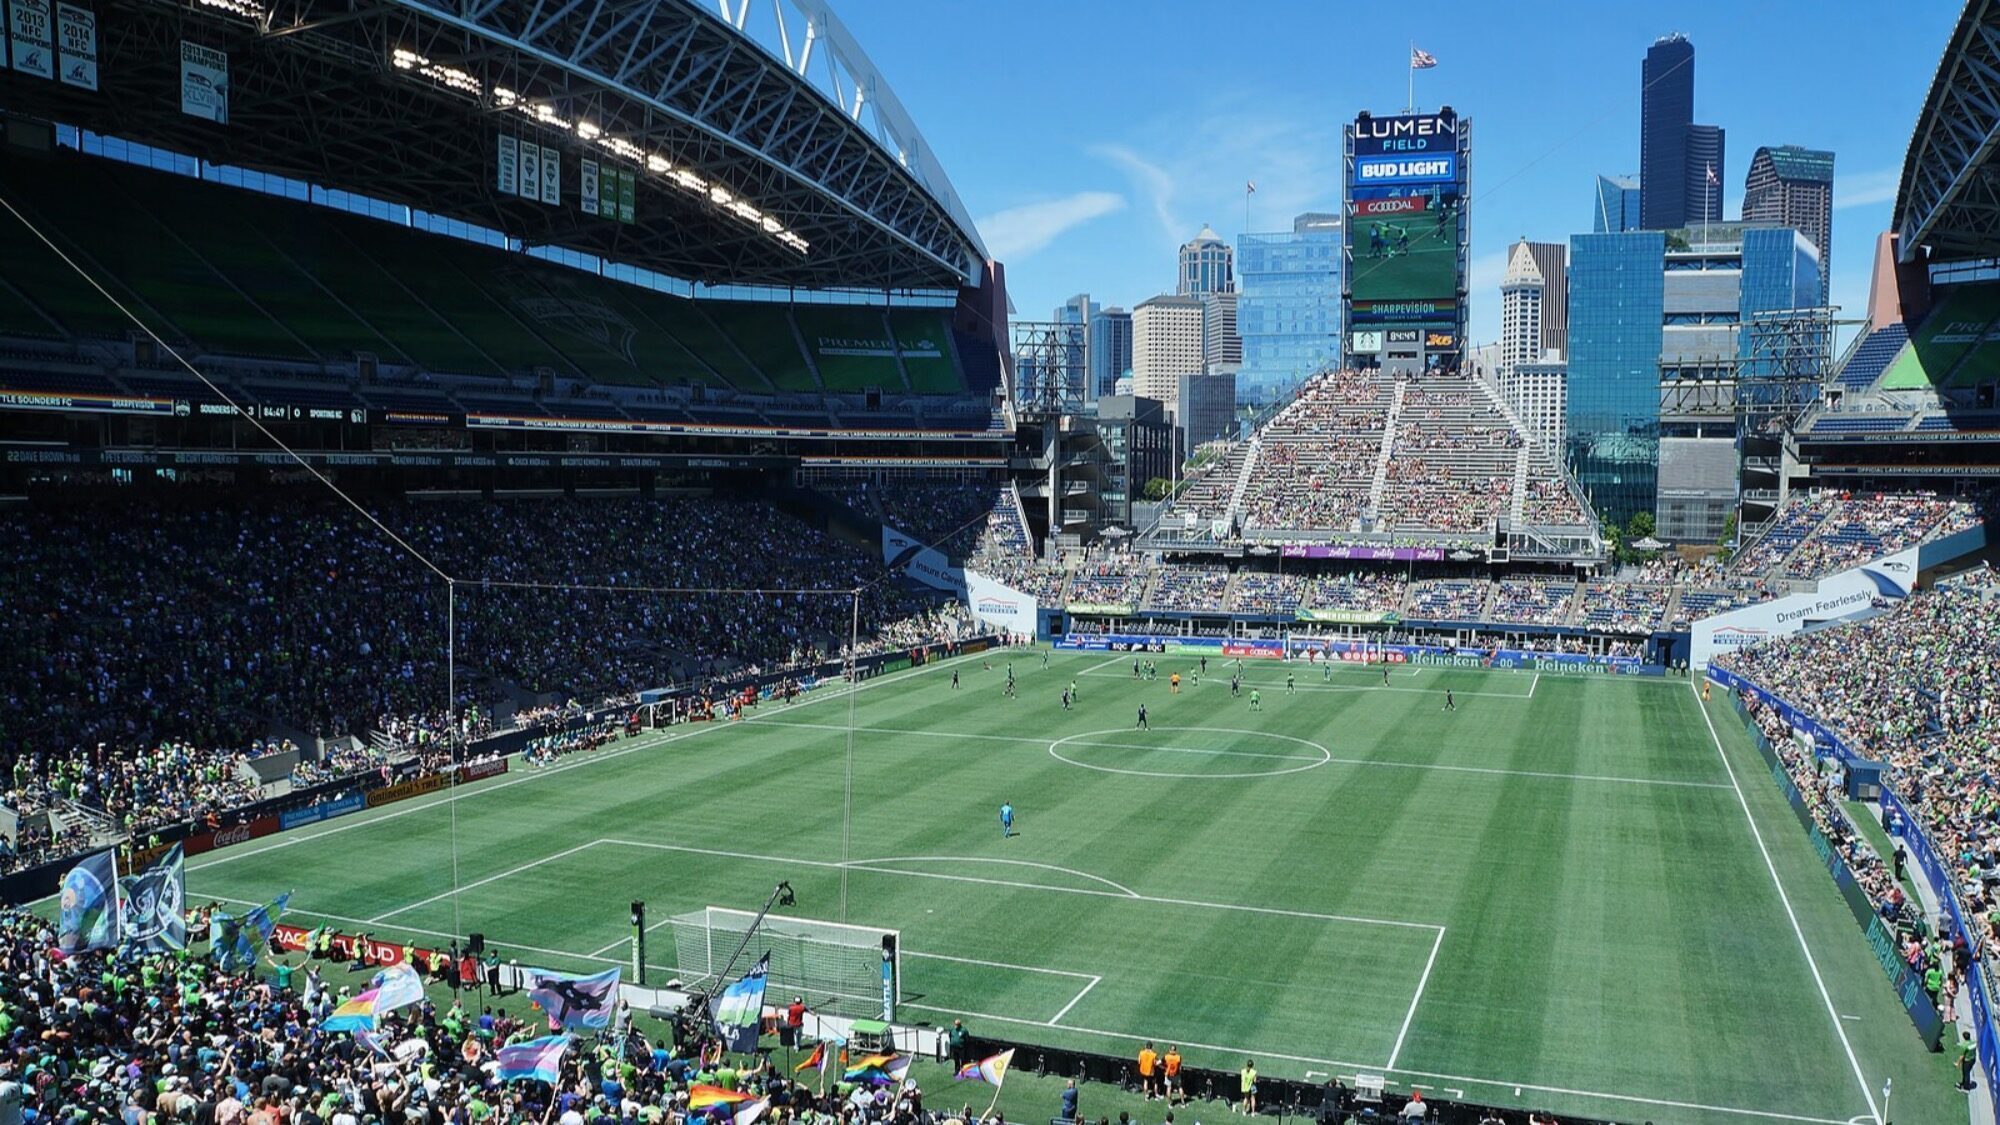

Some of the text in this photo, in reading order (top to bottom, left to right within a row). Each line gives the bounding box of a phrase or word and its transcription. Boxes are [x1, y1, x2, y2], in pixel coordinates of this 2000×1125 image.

[16, 8, 45, 28] 2013
[21, 23, 42, 38] NFC
[63, 22, 90, 42] 2014
[12, 32, 52, 50] CHAMPIONS
[68, 38, 88, 51] NFC
[60, 45, 97, 63] CHAMPIONS
[182, 42, 226, 63] 2013 WORLD
[182, 53, 226, 73] CHAMPIONS
[1355, 118, 1455, 138] LUMEN
[1383, 138, 1427, 151] FIELD
[1362, 161, 1449, 178] BUD LIGHT
[1372, 301, 1435, 315] SHARPEVISION
[1390, 331, 1416, 341] 84:49
[19, 396, 60, 406] SOUNDERS
[61, 398, 73, 407] FC
[112, 398, 155, 409] SHARPEVISION
[200, 404, 230, 415] SOUNDERS
[248, 406, 254, 415] 3
[263, 407, 285, 417] 84:49
[294, 408, 300, 417] 0
[309, 409, 333, 419] SPORTING
[7, 451, 19, 462] 22
[20, 451, 38, 462] DAVE
[39, 452, 65, 463] BROWN
[915, 561, 976, 594] Insure Carefully
[1776, 589, 1872, 624] Dream Fearlessly
[1411, 652, 1479, 668] Heineken
[1535, 659, 1605, 674] Heineken
[366, 780, 437, 807] Continental TIRE
[1867, 915, 1901, 985] Heineken
